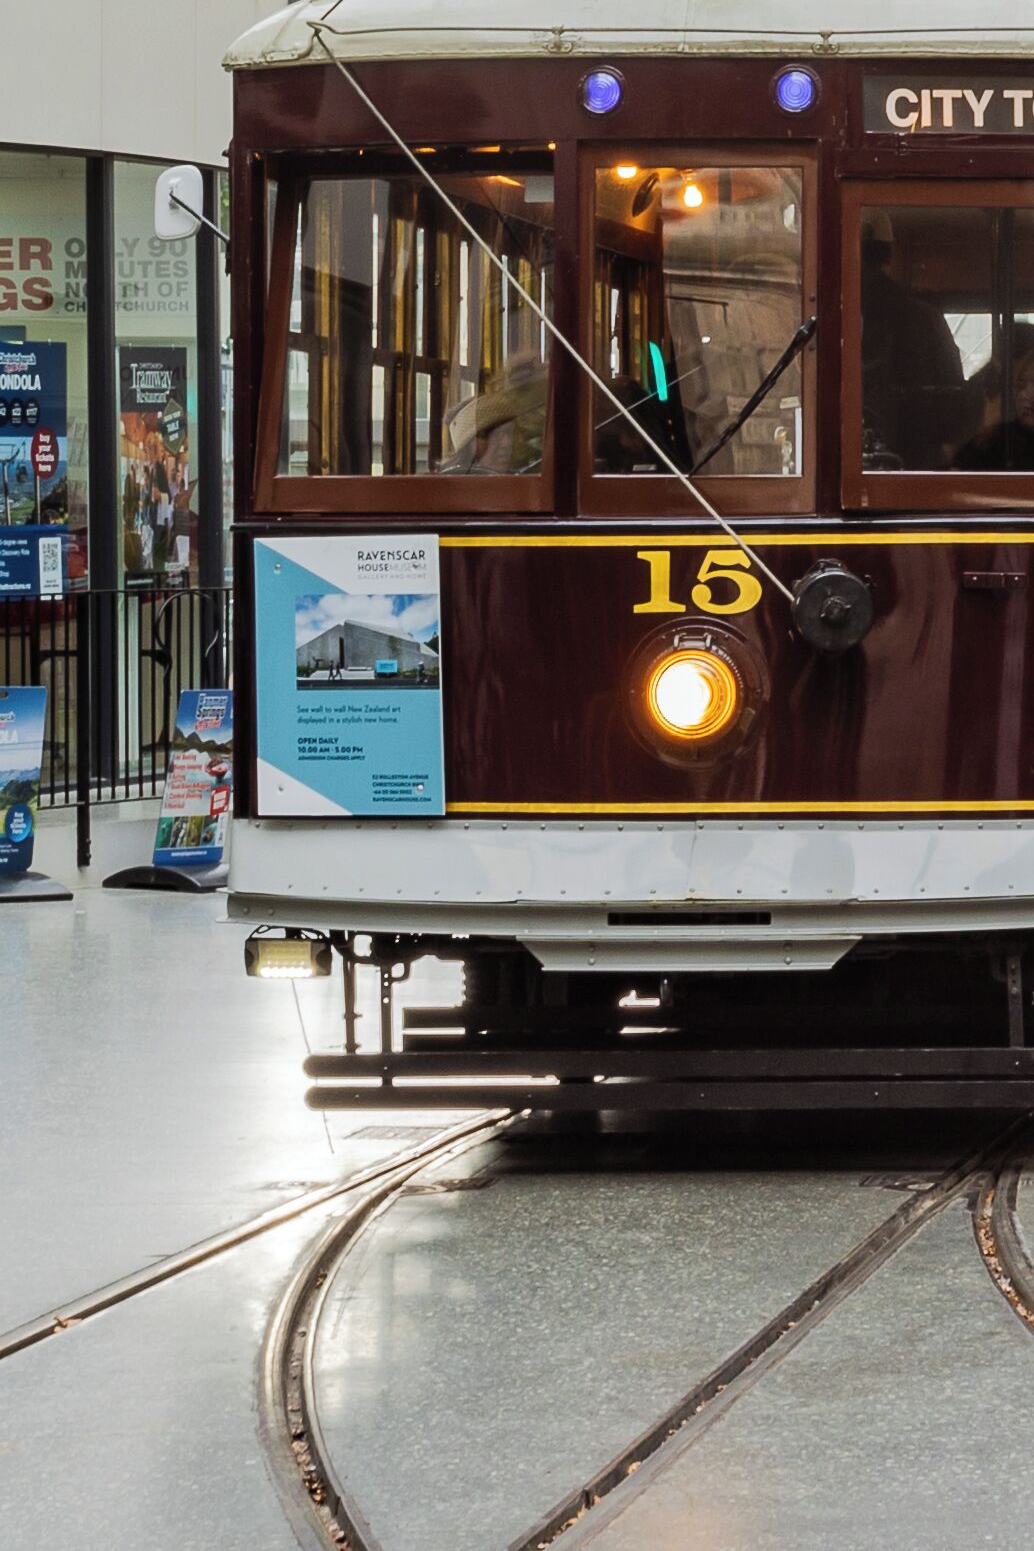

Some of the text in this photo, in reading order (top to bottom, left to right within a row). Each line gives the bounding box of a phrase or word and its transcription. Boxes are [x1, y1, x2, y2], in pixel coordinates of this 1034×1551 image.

[885, 88, 994, 128] CITY
[147, 238, 188, 258] 90
[157, 282, 189, 298] OF
[130, 363, 173, 391] Tramway
[358, 550, 426, 560] RAVENSCAR
[633, 550, 762, 614] 15
[297, 705, 401, 713] See wall to wall New Zealand art
[297, 716, 326, 725] displayed
[342, 716, 362, 725] stylish
